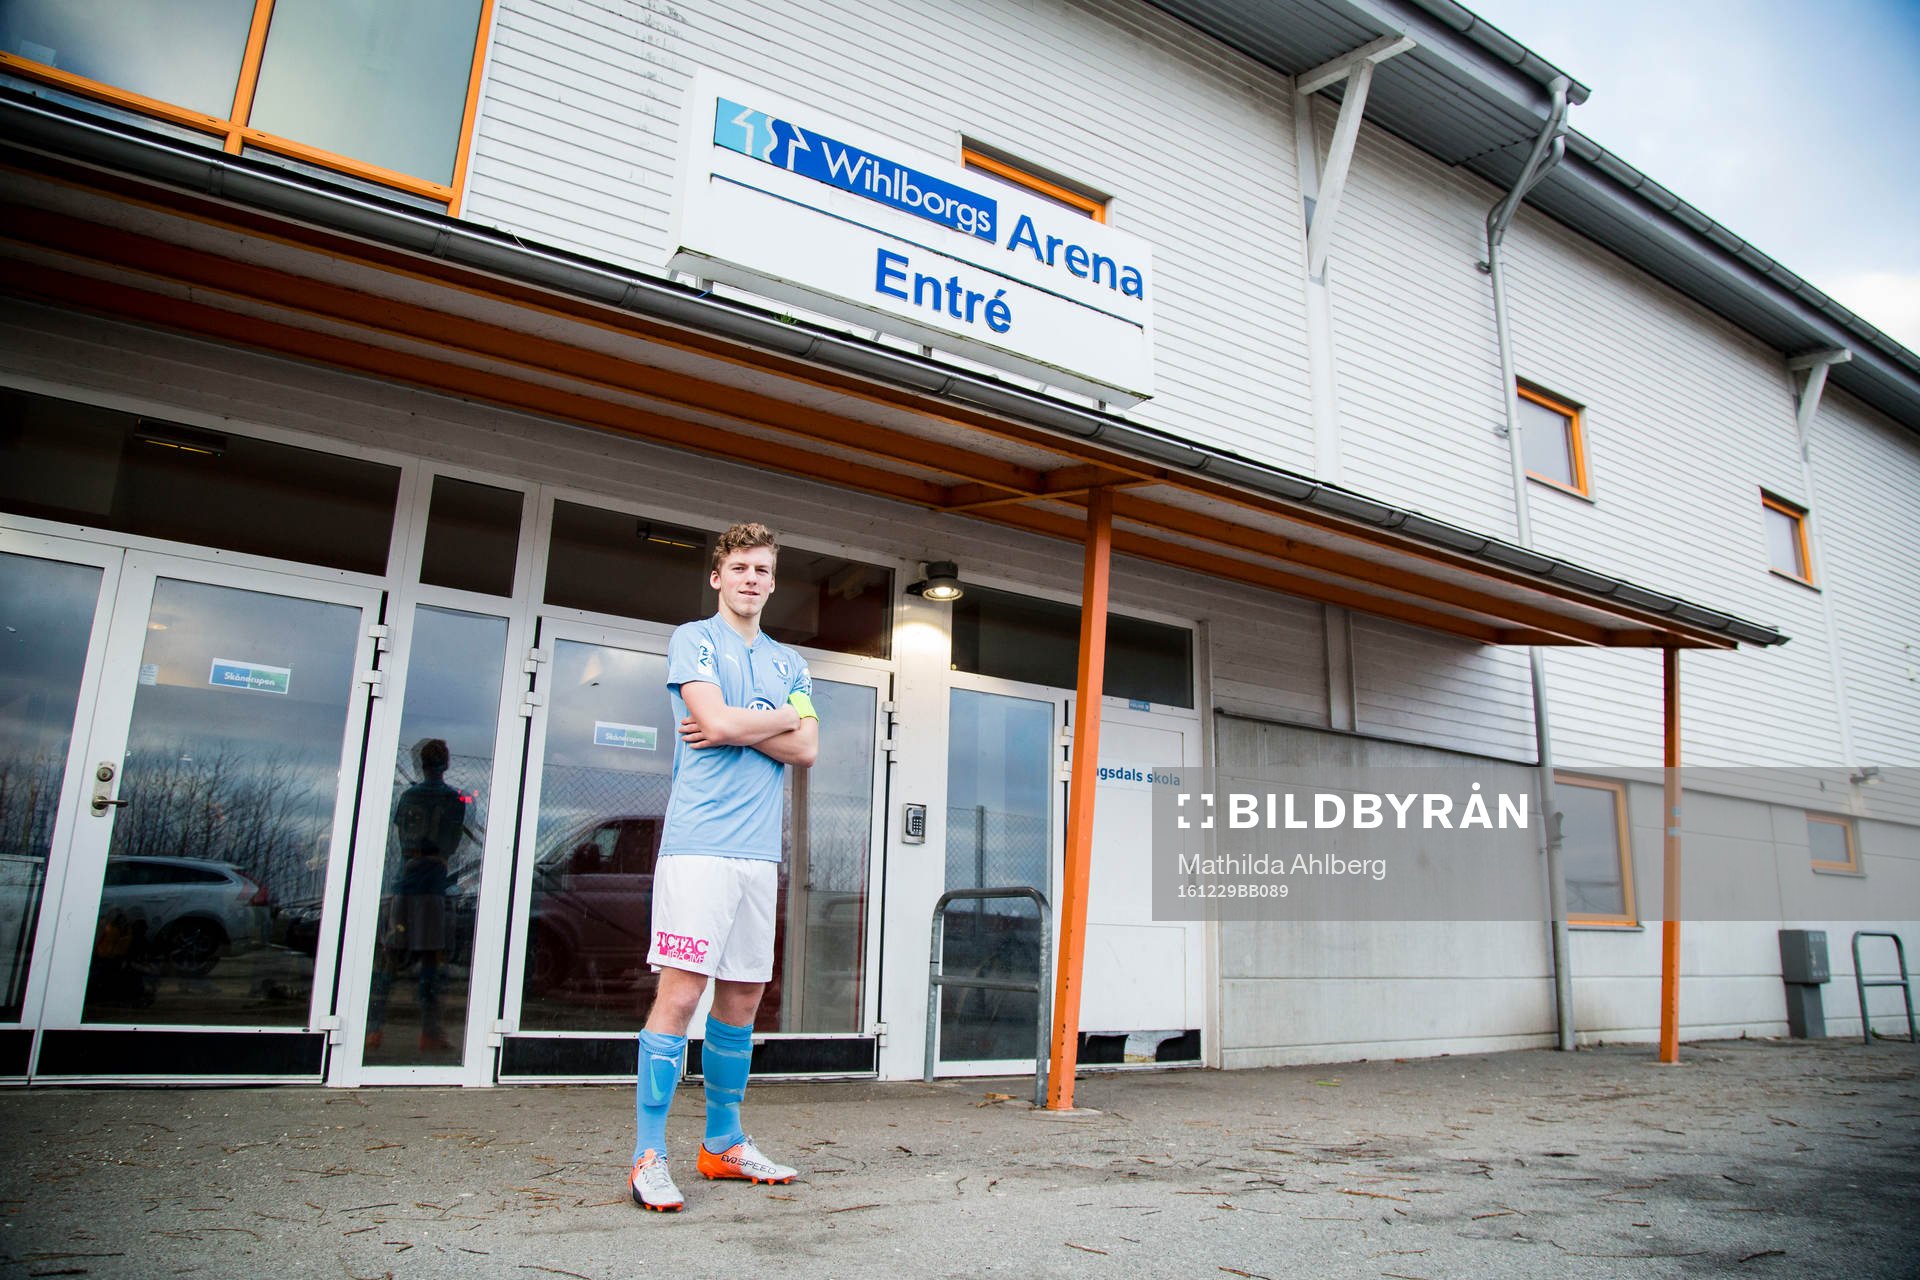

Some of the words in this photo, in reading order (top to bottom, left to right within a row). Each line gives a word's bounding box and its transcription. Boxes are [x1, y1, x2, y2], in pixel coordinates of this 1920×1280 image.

[822, 141, 991, 235] Wihlborgs
[1006, 214, 1144, 301] Arena
[875, 247, 1012, 334] Entré
[1146, 771, 1180, 786] skola
